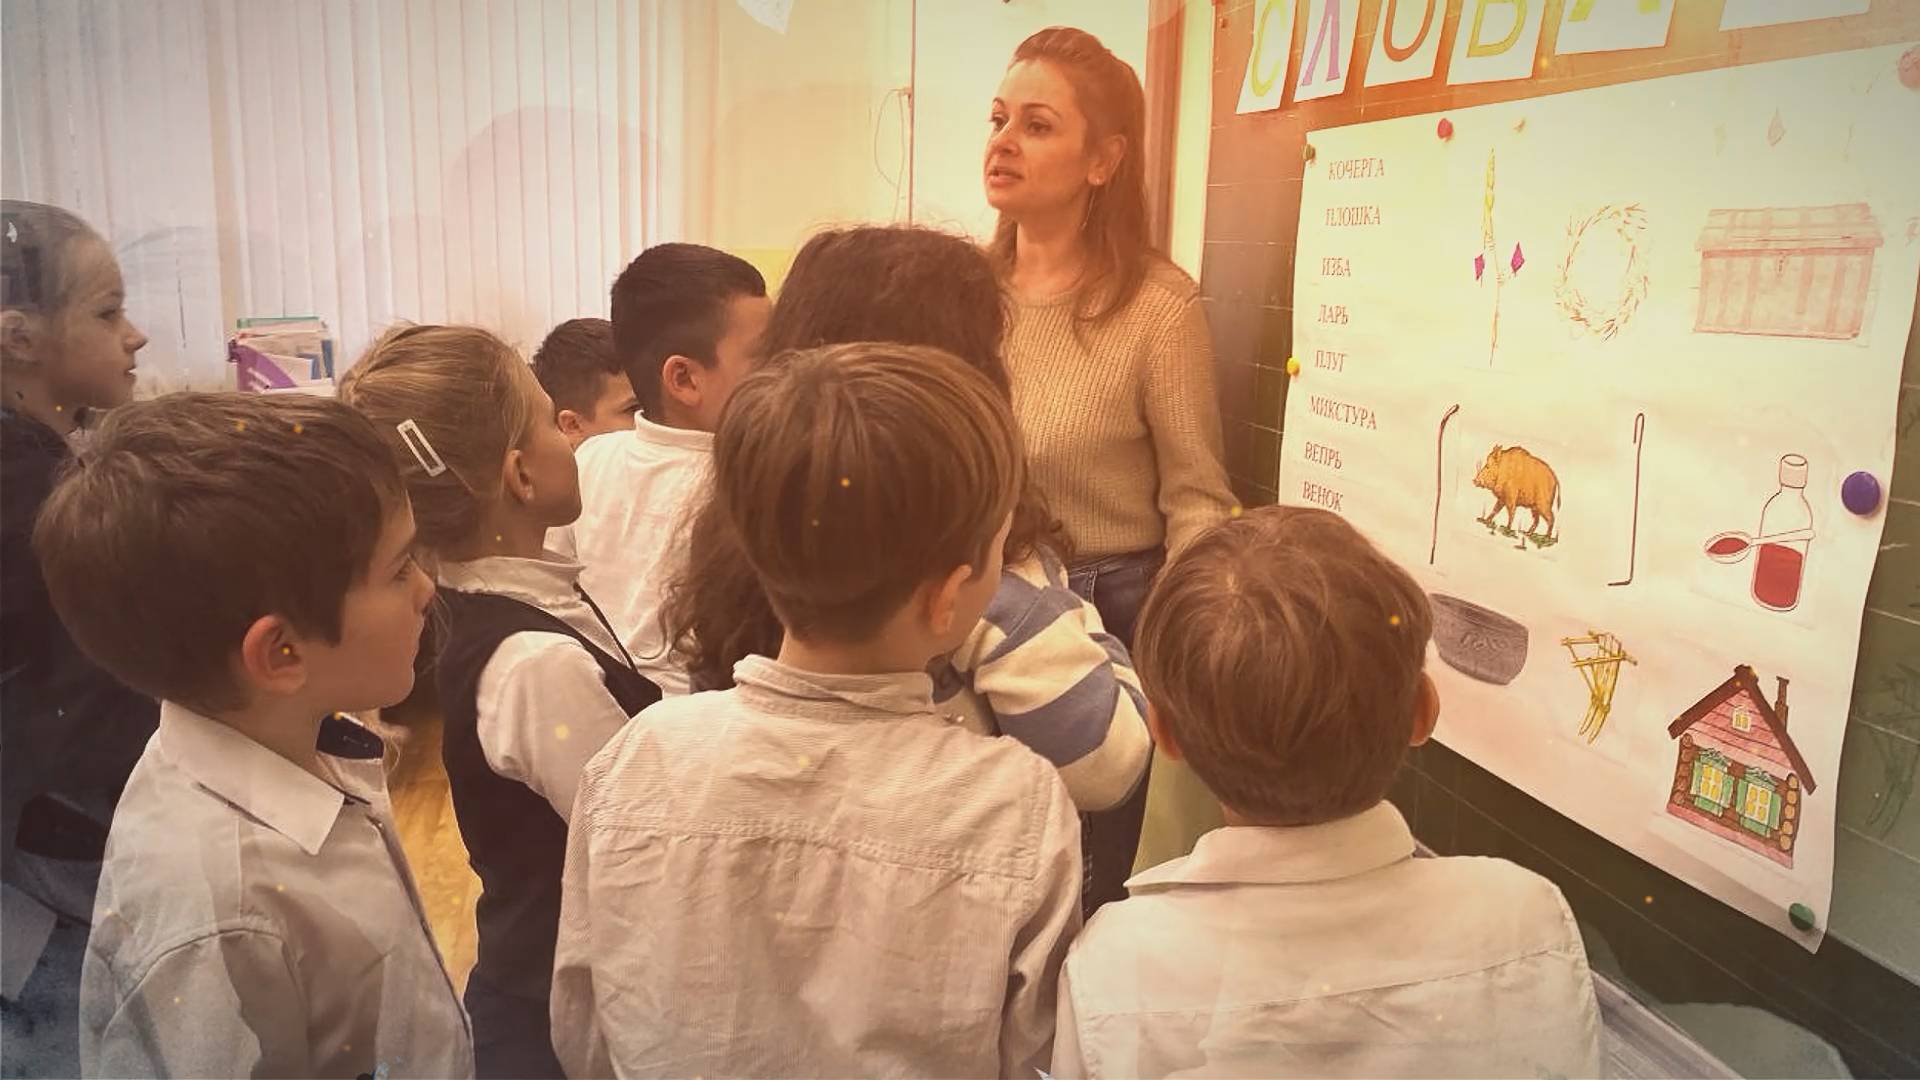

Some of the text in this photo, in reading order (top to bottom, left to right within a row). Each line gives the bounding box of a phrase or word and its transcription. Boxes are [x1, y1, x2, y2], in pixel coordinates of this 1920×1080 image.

[1329, 158, 1384, 180] КОЧЕРГА
[1326, 206, 1381, 226] ПЛОШКА
[1322, 257, 1351, 277] ИЗБА
[1317, 304, 1348, 325] ЛАРЬ
[1315, 350, 1348, 372] ПЛУГ
[1310, 396, 1377, 430] МИКСТУРА
[1304, 441, 1342, 470] ВЕПРЬ
[1302, 481, 1343, 512] ВЕНОК
